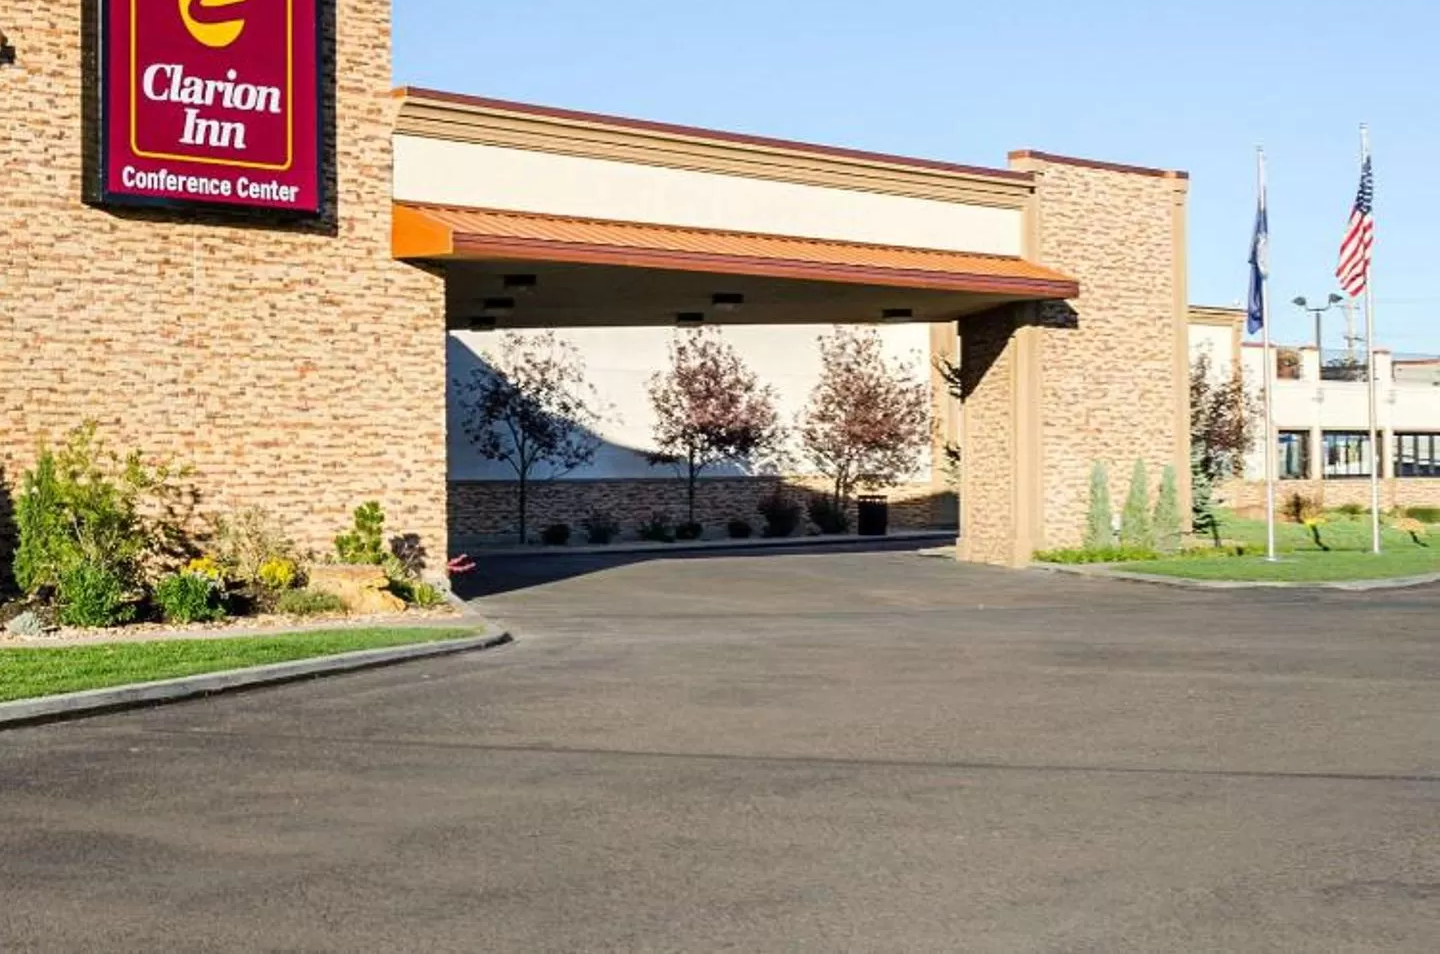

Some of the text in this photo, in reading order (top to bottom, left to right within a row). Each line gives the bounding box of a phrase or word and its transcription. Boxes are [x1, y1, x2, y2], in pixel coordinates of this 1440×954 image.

[142, 63, 281, 113] Clarion
[179, 108, 246, 149] Inn
[122, 165, 299, 202] Conference Center
